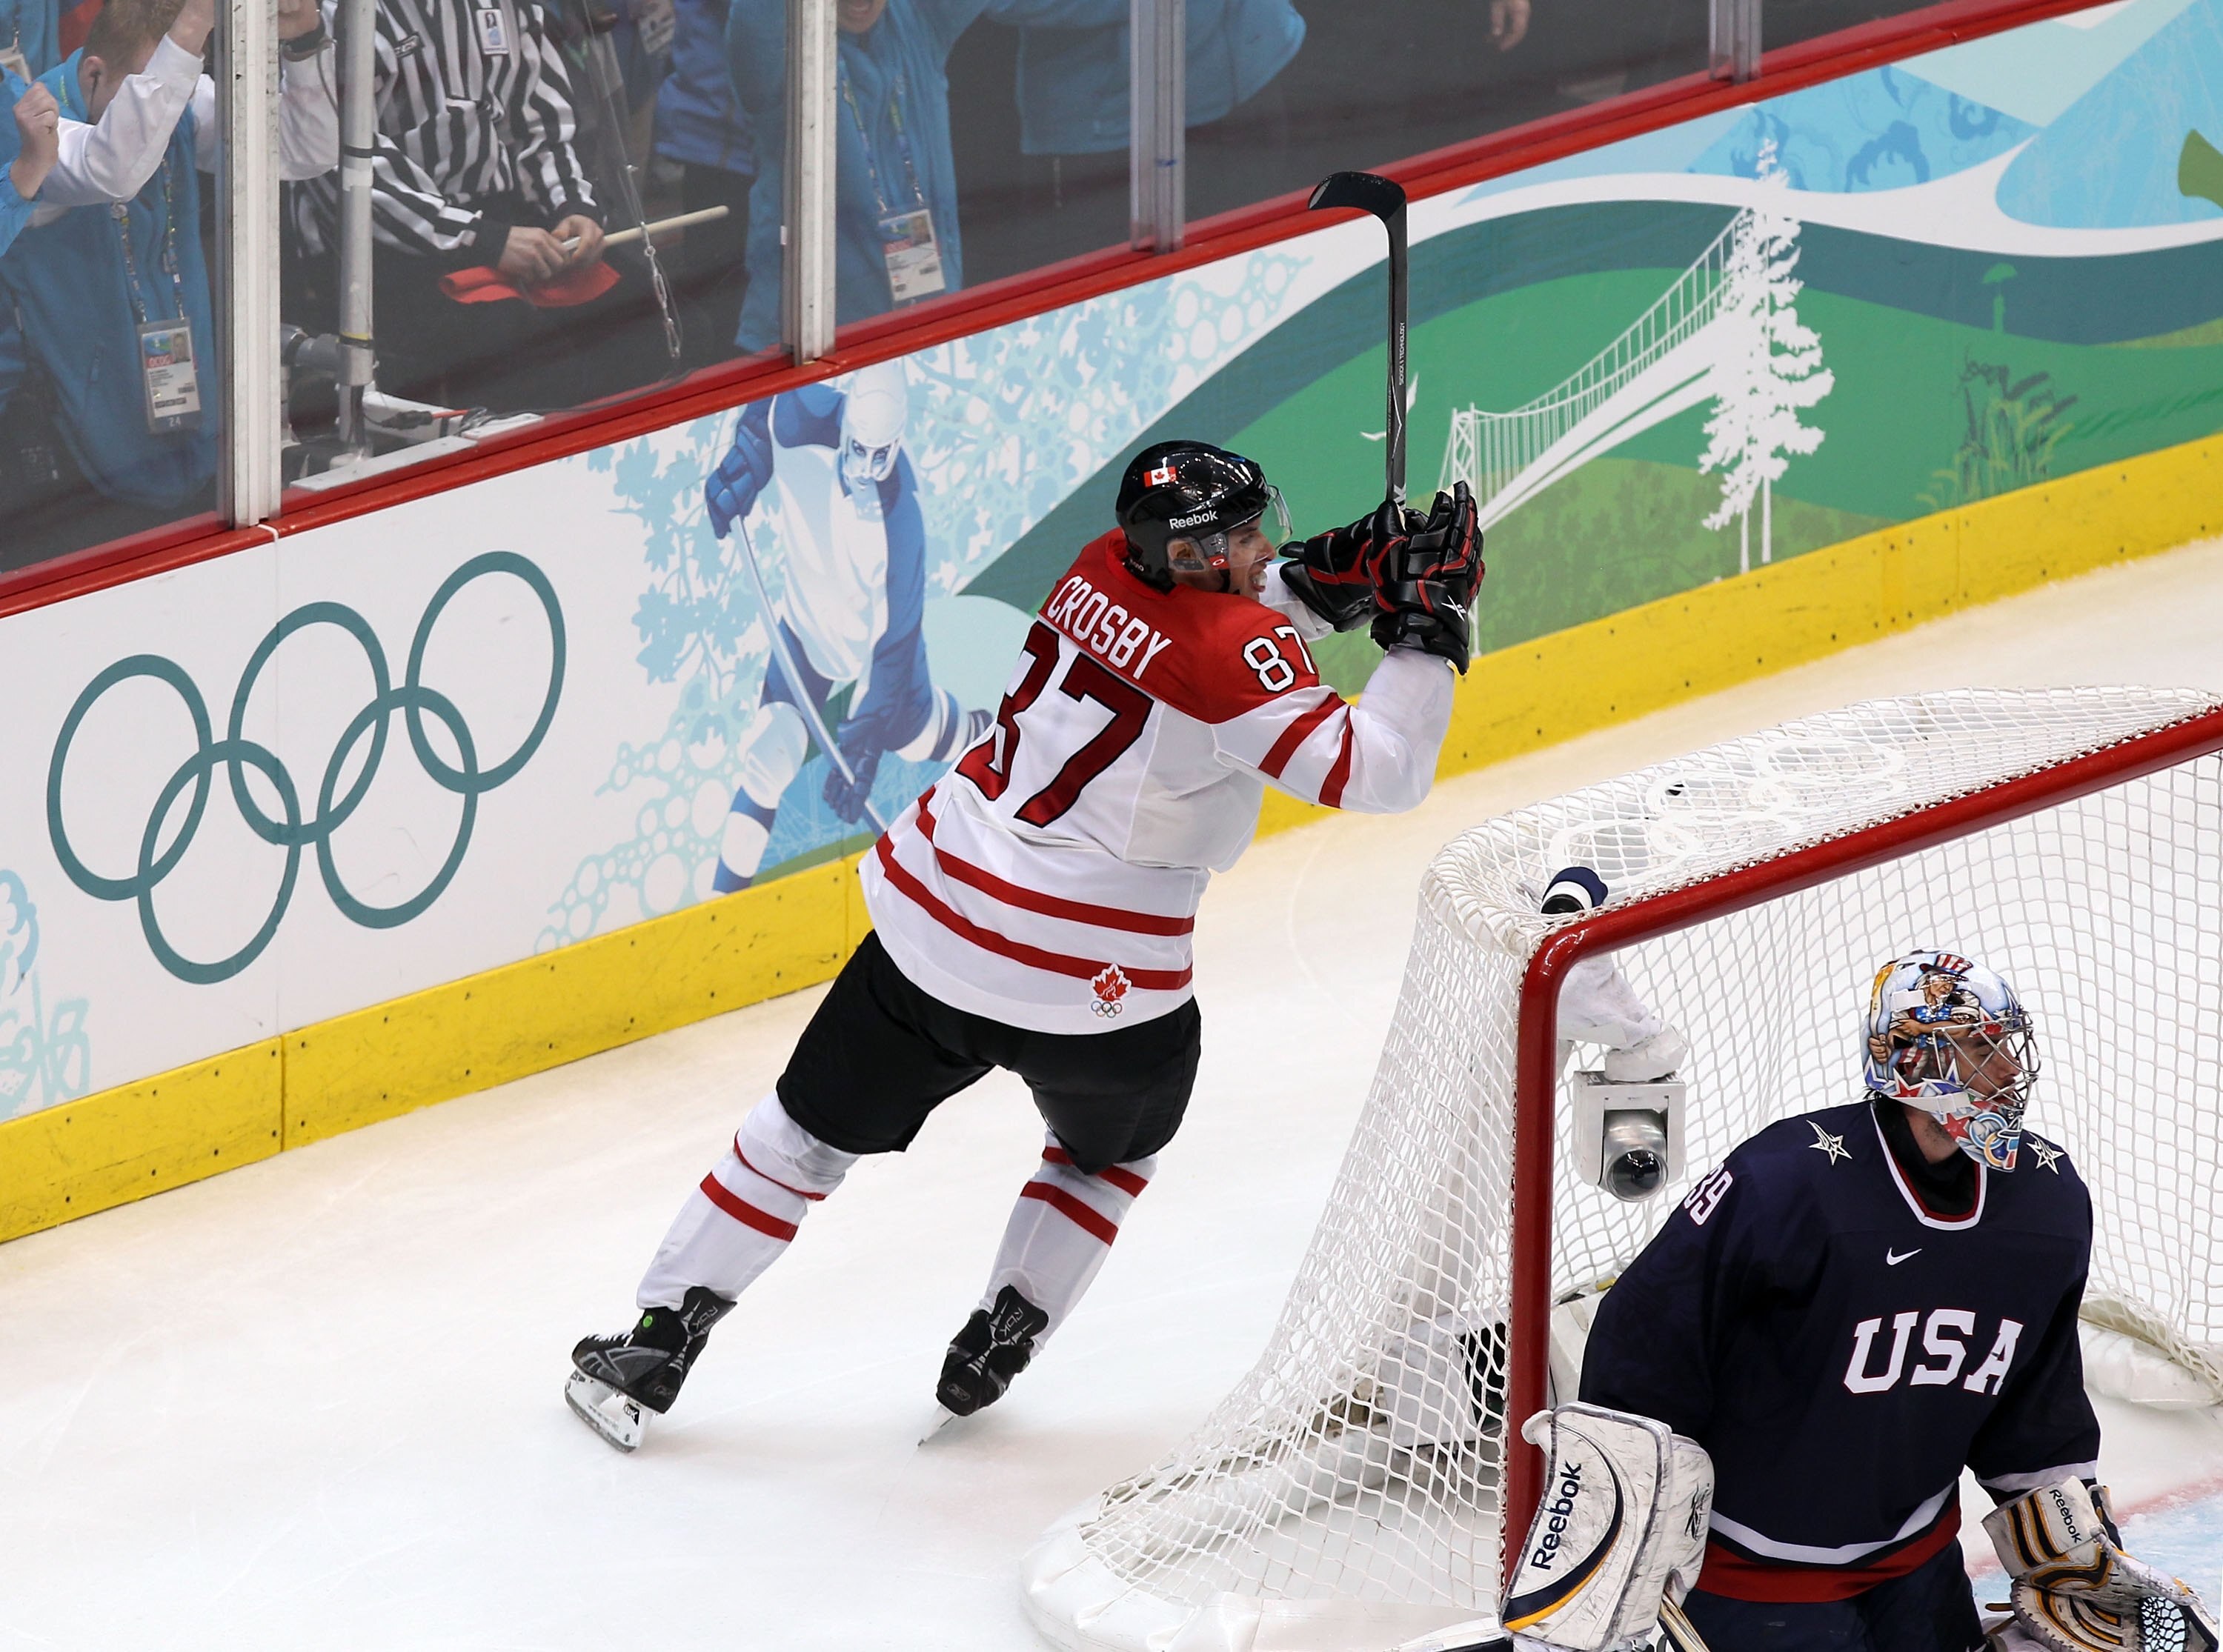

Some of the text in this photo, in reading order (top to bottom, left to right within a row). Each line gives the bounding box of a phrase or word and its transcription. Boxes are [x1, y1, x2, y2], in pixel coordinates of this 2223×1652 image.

[1169, 510, 1219, 530] Reebok
[1047, 575, 1172, 680] CROSBY
[1242, 625, 1316, 692] 87
[1684, 1162, 1733, 1226] 39
[1843, 1308, 2024, 1395] USA
[1530, 1459, 1582, 1571] Reebok
[2049, 1489, 2082, 1544] Reebok
